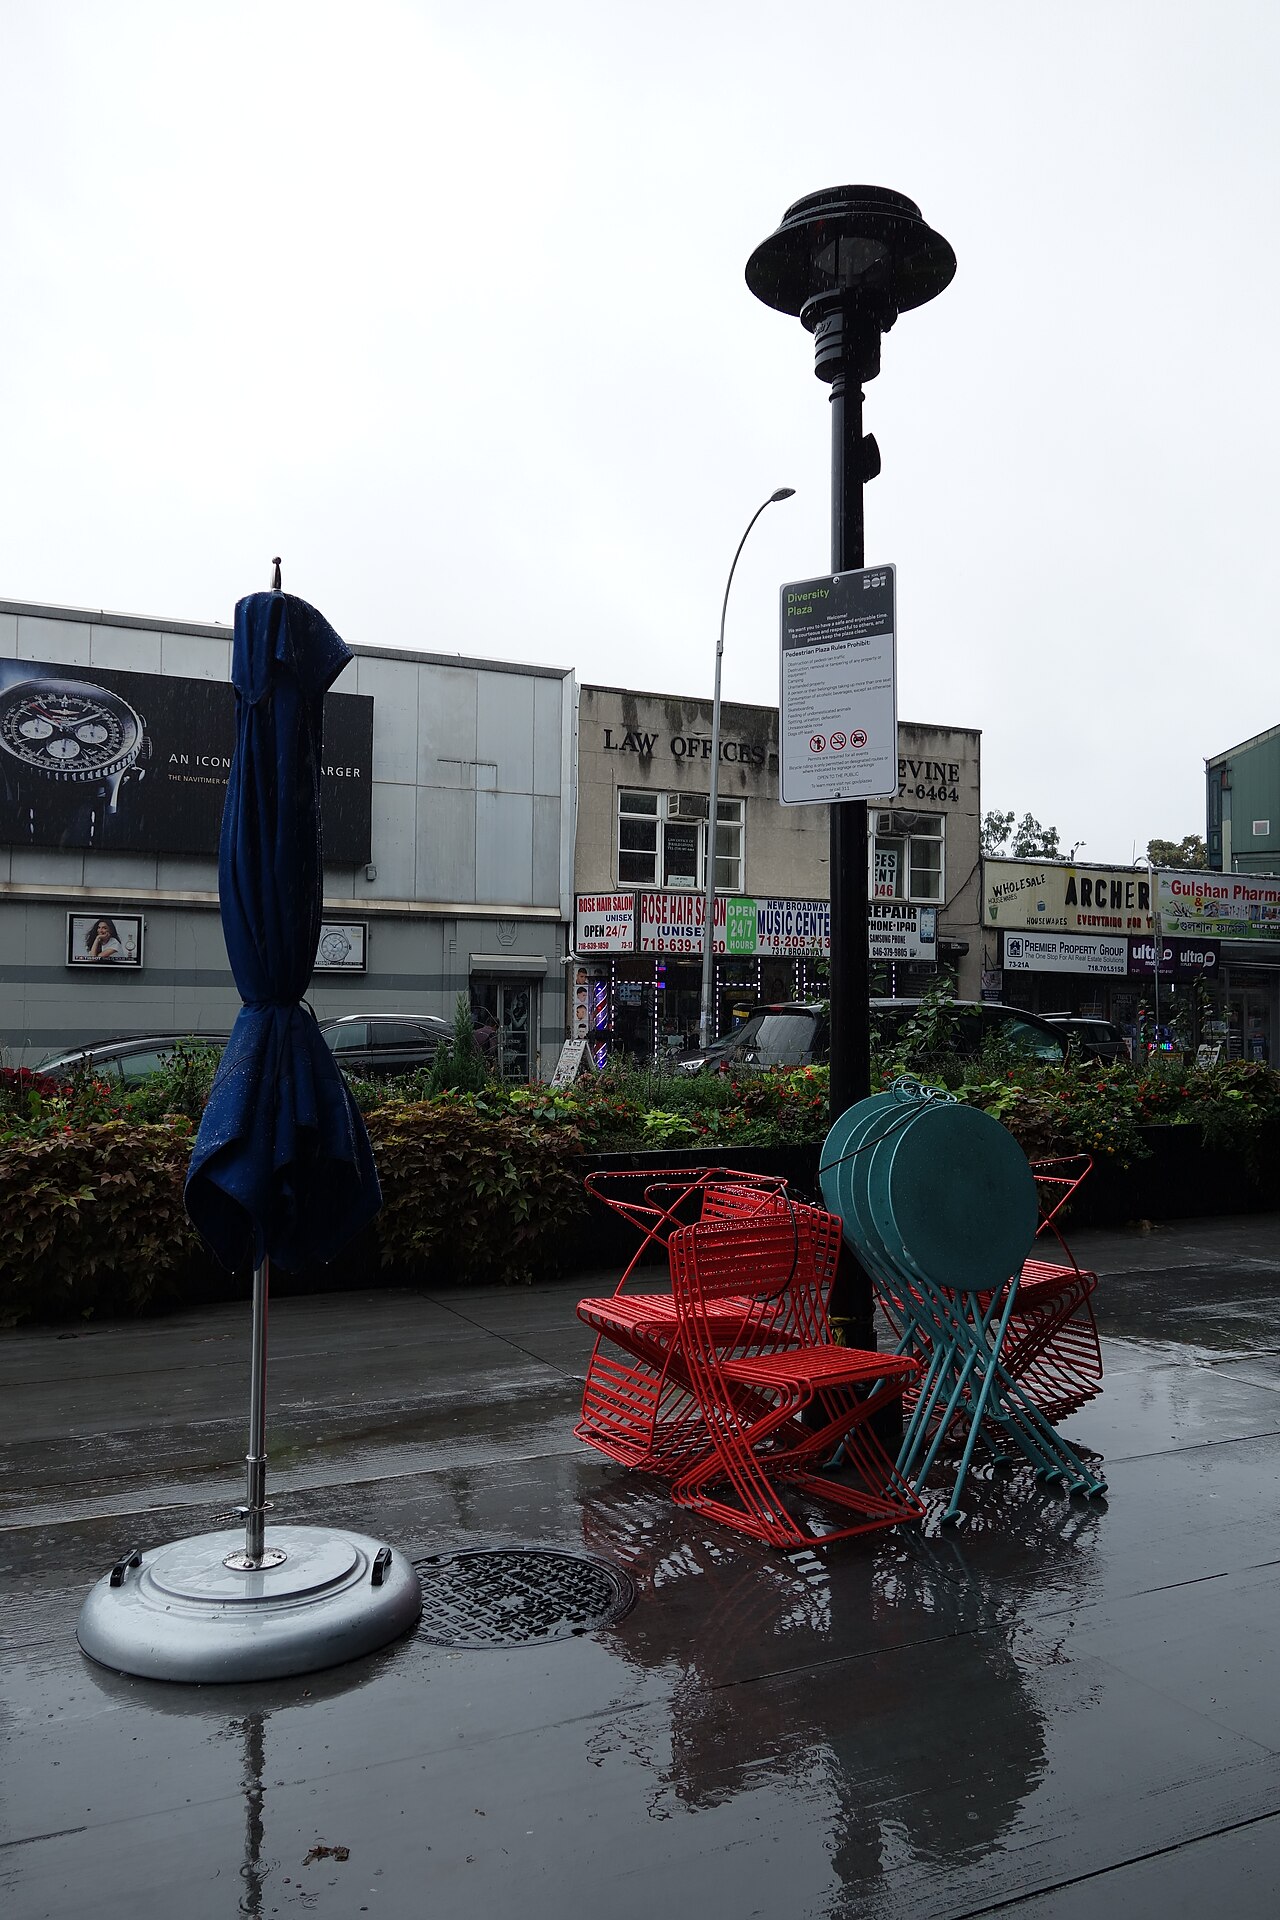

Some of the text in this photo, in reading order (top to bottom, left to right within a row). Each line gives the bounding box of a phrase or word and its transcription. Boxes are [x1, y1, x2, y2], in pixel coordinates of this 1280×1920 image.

[864, 576, 886, 589] DOT
[788, 589, 829, 603] Diversity
[788, 606, 812, 616] Plaza
[854, 615, 876, 623] enjoyable
[830, 625, 853, 634] respectful
[785, 649, 814, 658] Pedestrian
[847, 640, 870, 648] Prohibit:
[604, 729, 765, 764] LAW OFFICES
[169, 753, 189, 765] AN
[182, 776, 220, 785] NAVITIMER
[993, 874, 1046, 900] WHOLESALE
[1065, 876, 1150, 910] ARCHER
[1171, 880, 1228, 899] Gulshan
[579, 896, 632, 912] ROSE HAIR SALON
[988, 894, 1018, 904] HOUSEWARES
[1194, 897, 1202, 907] &
[642, 895, 726, 926] ROSE HAIR SAON
[728, 905, 755, 917] OPEN
[767, 901, 828, 912] NEW BROADWAY
[758, 910, 792, 935] MUSIC
[1027, 917, 1068, 926] HOUSEWARES
[1077, 914, 1141, 929] EVERYTHING FOR
[584, 924, 628, 938] OPEN 24/7
[731, 919, 753, 939] 24/7
[730, 940, 753, 950] HOURS
[1025, 940, 1124, 957] PREMIER PROPERTY GROUP
[1046, 953, 1058, 961] Stop
[1180, 950, 1203, 964] ultra
